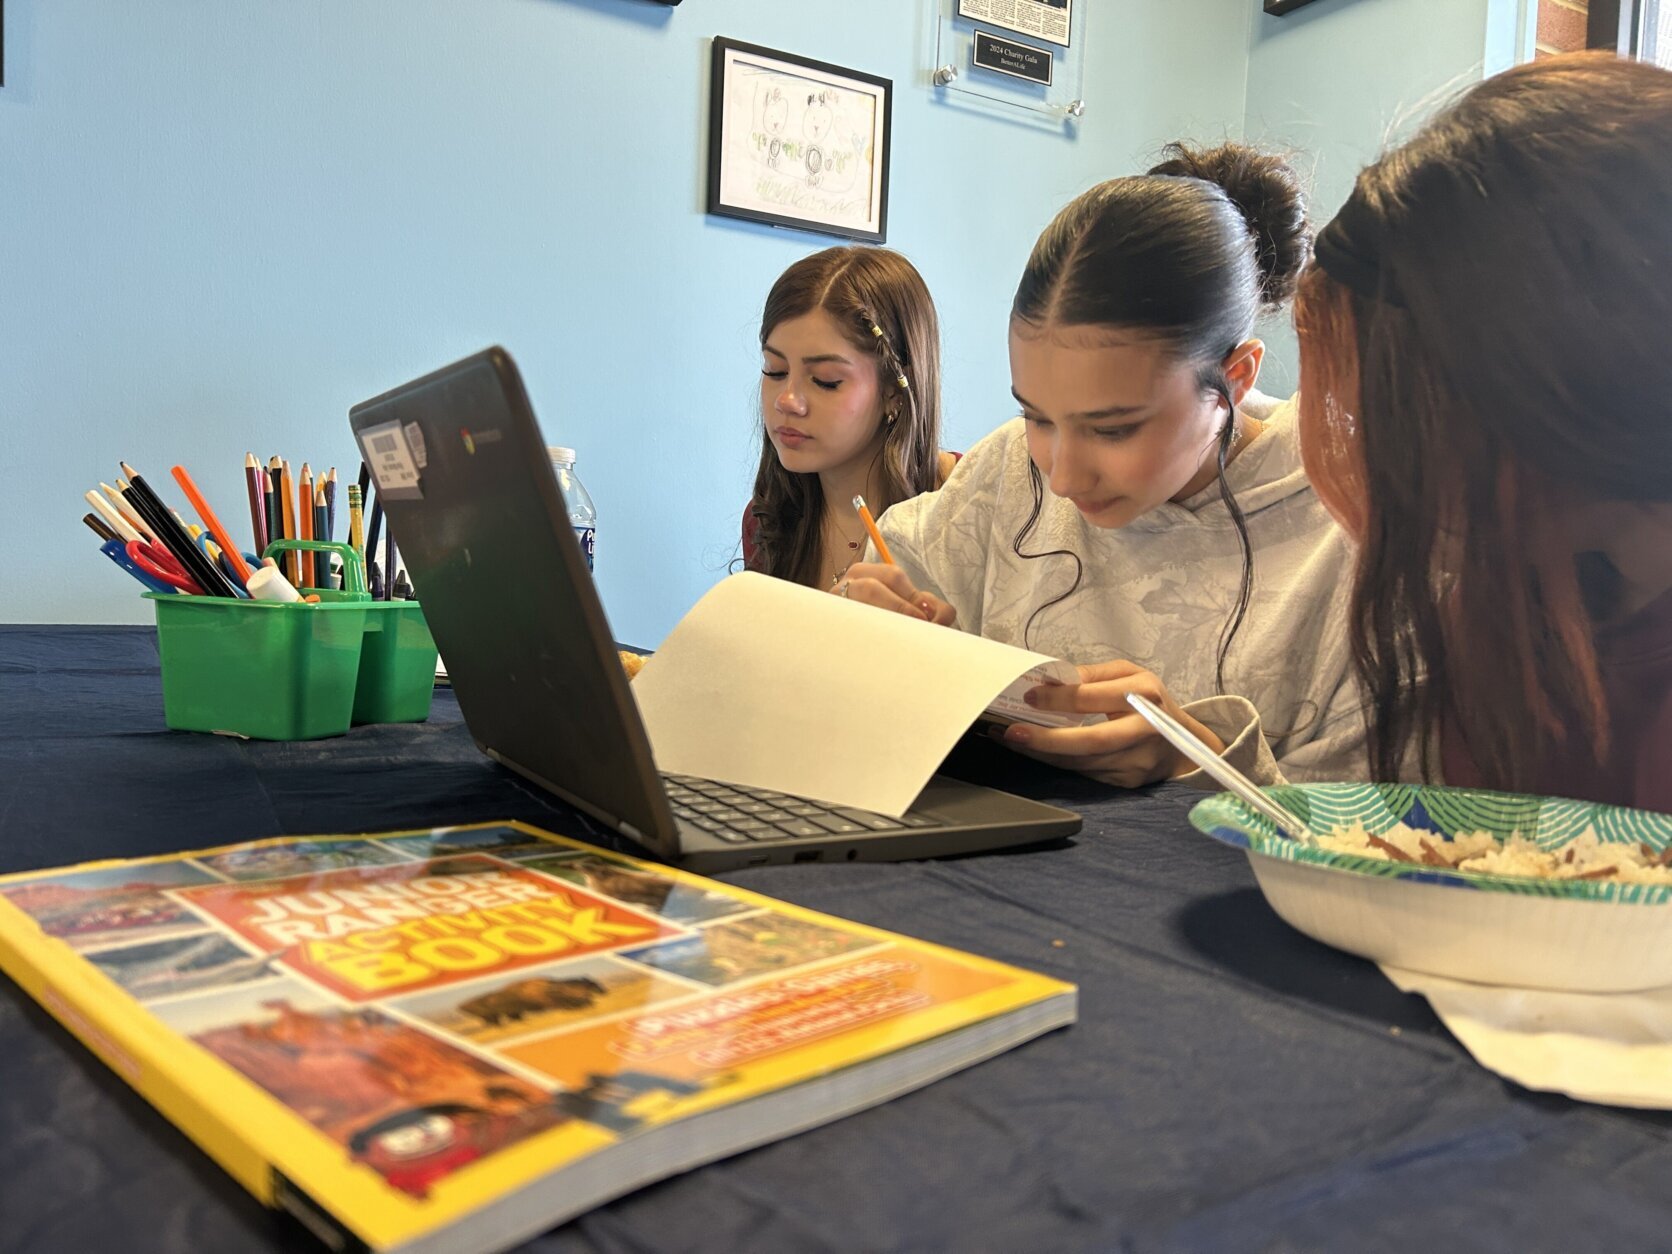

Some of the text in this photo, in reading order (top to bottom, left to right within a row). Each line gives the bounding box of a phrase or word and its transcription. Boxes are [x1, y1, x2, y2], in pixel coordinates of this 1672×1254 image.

[989, 44, 1038, 64] 2024 Charity Gala
[250, 873, 504, 924] JUNIOR
[261, 881, 553, 944] RANGER
[309, 897, 575, 962] ACTIVITY
[326, 906, 655, 993] BOOK
